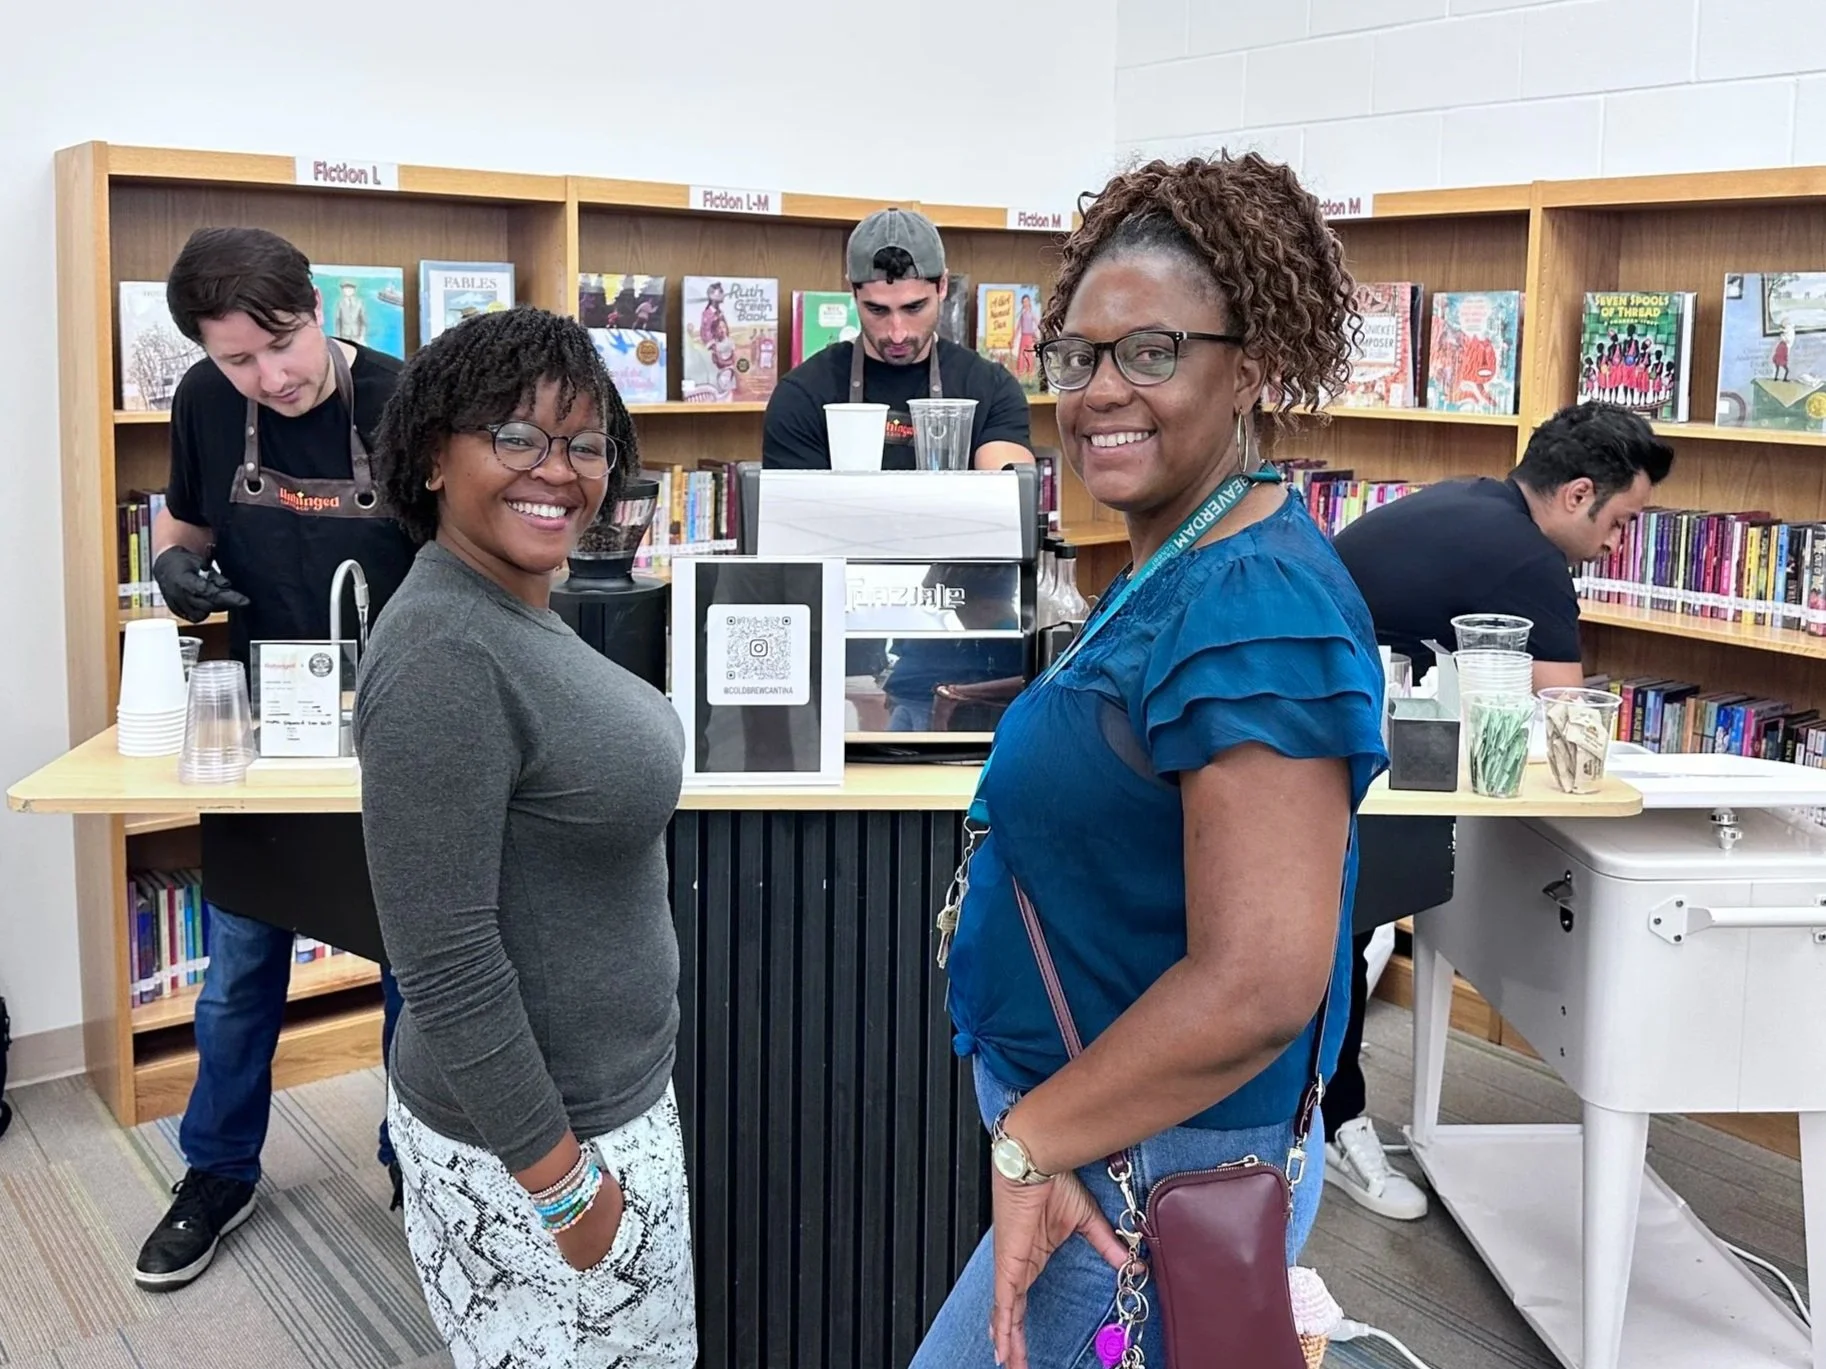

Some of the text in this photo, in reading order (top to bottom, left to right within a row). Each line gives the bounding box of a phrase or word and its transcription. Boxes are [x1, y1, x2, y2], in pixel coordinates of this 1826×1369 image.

[313, 160, 382, 185] Fiction L
[703, 190, 769, 212] Fiction L-M
[1320, 197, 1361, 216] tion M
[1018, 212, 1061, 229] Fiction M
[444, 276, 497, 289] FABLES
[728, 283, 764, 299] Ruth
[734, 299, 773, 313] Green
[1595, 294, 1669, 306] SEVEN SPOOLS
[737, 311, 768, 322] Book
[1601, 306, 1661, 317] OF THREAD
[723, 687, 793, 695] @COLDBREWCANTINA
